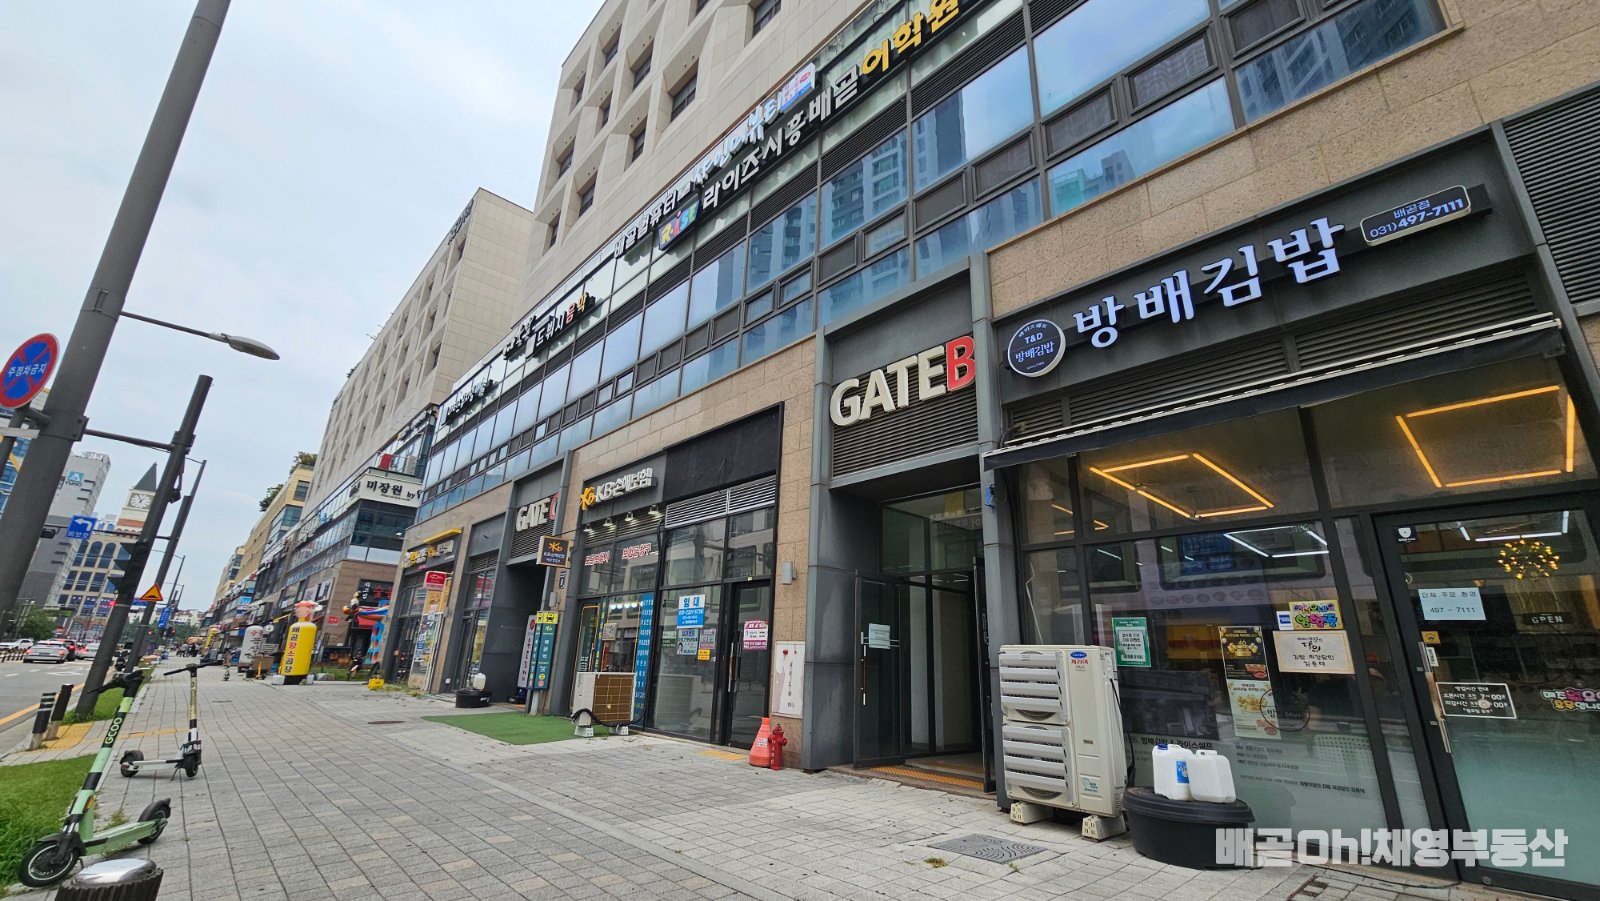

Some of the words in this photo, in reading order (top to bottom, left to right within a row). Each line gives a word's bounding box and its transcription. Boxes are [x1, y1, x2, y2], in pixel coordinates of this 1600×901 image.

[1394, 199, 1431, 219] 배곧점
[1072, 217, 1345, 348] 방배김밥
[1025, 332, 1043, 344] T&D
[1015, 341, 1055, 363] 방배김밥
[7, 363, 48, 378] 주정차금지
[366, 480, 403, 496] 미장원
[406, 491, 416, 500] by
[595, 467, 653, 503] KB손해보험
[1531, 615, 1563, 624] OPEN
[105, 717, 122, 744] GCOO
